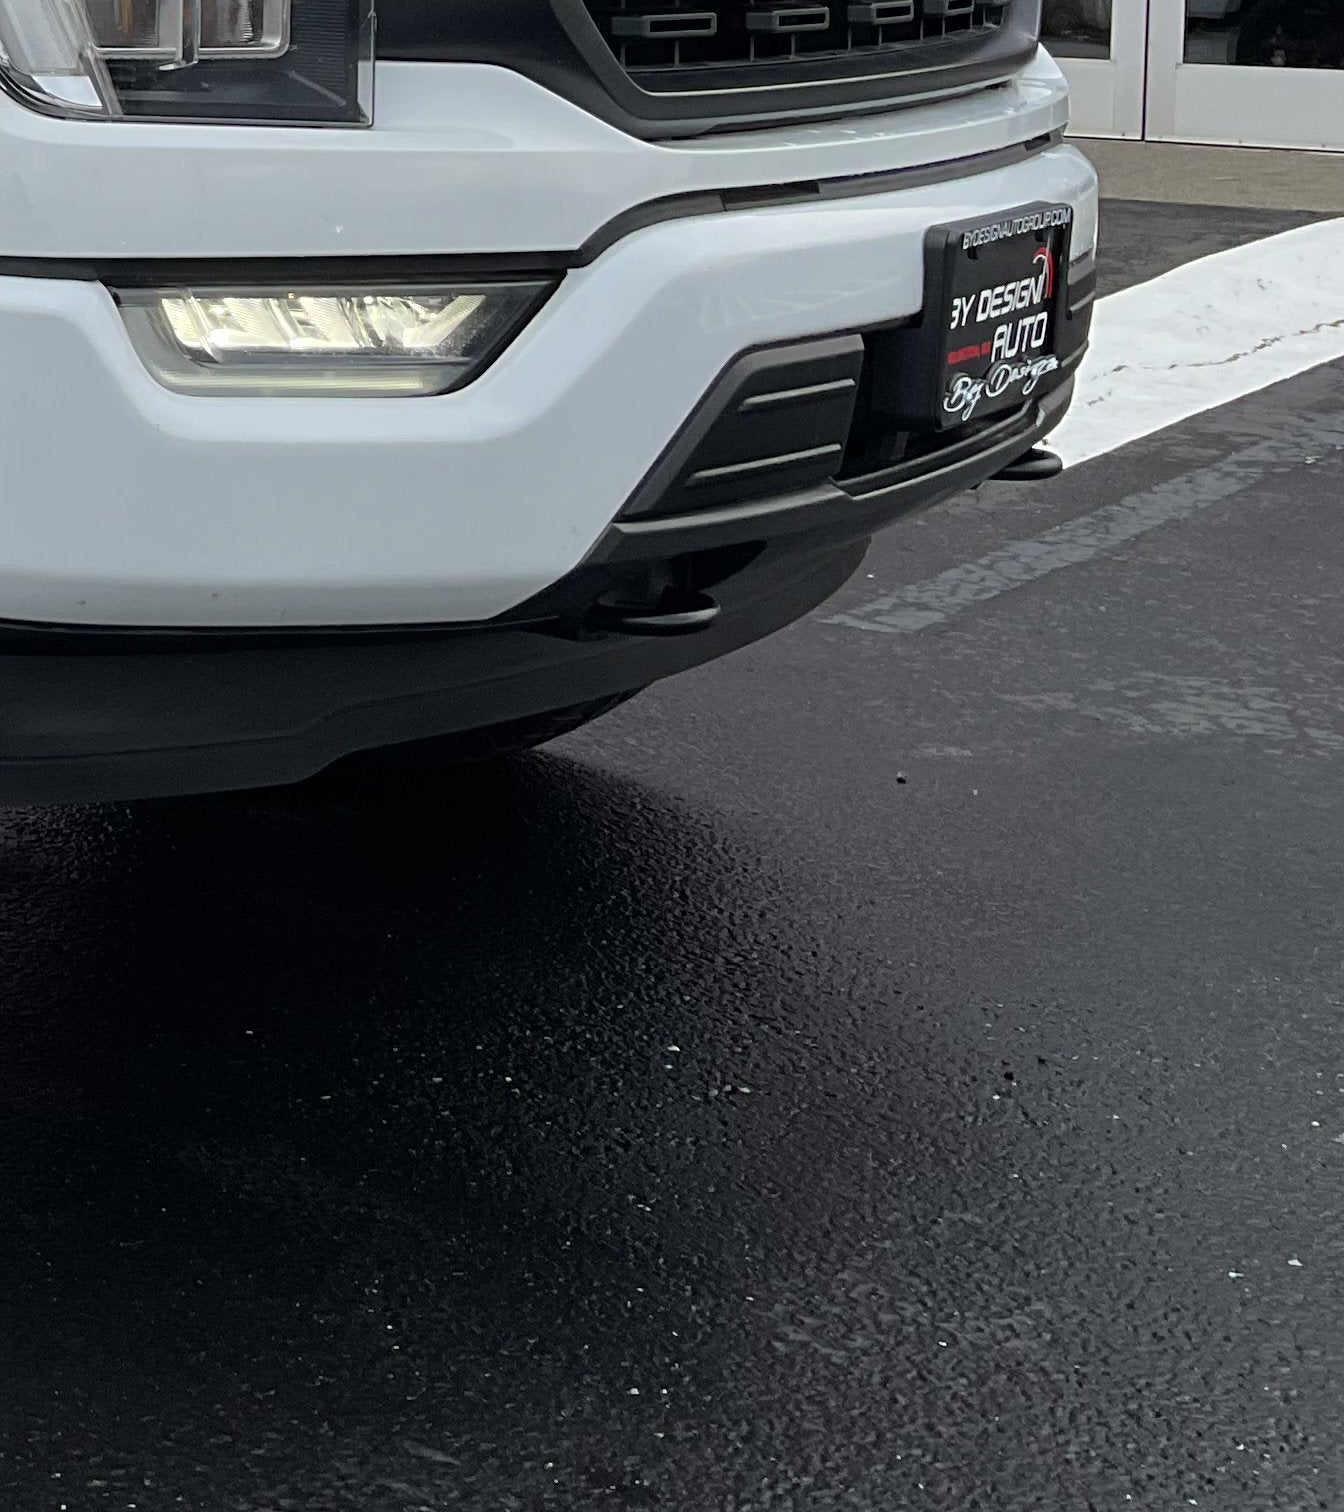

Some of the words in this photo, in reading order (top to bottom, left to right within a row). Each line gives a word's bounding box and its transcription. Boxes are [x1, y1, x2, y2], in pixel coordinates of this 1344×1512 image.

[962, 207, 1072, 250] BYDESIGNAUTOGROUP.COM
[950, 293, 976, 330] BY
[975, 273, 1043, 323] DESIGN
[991, 311, 1048, 363] AUTO
[943, 376, 985, 422] By
